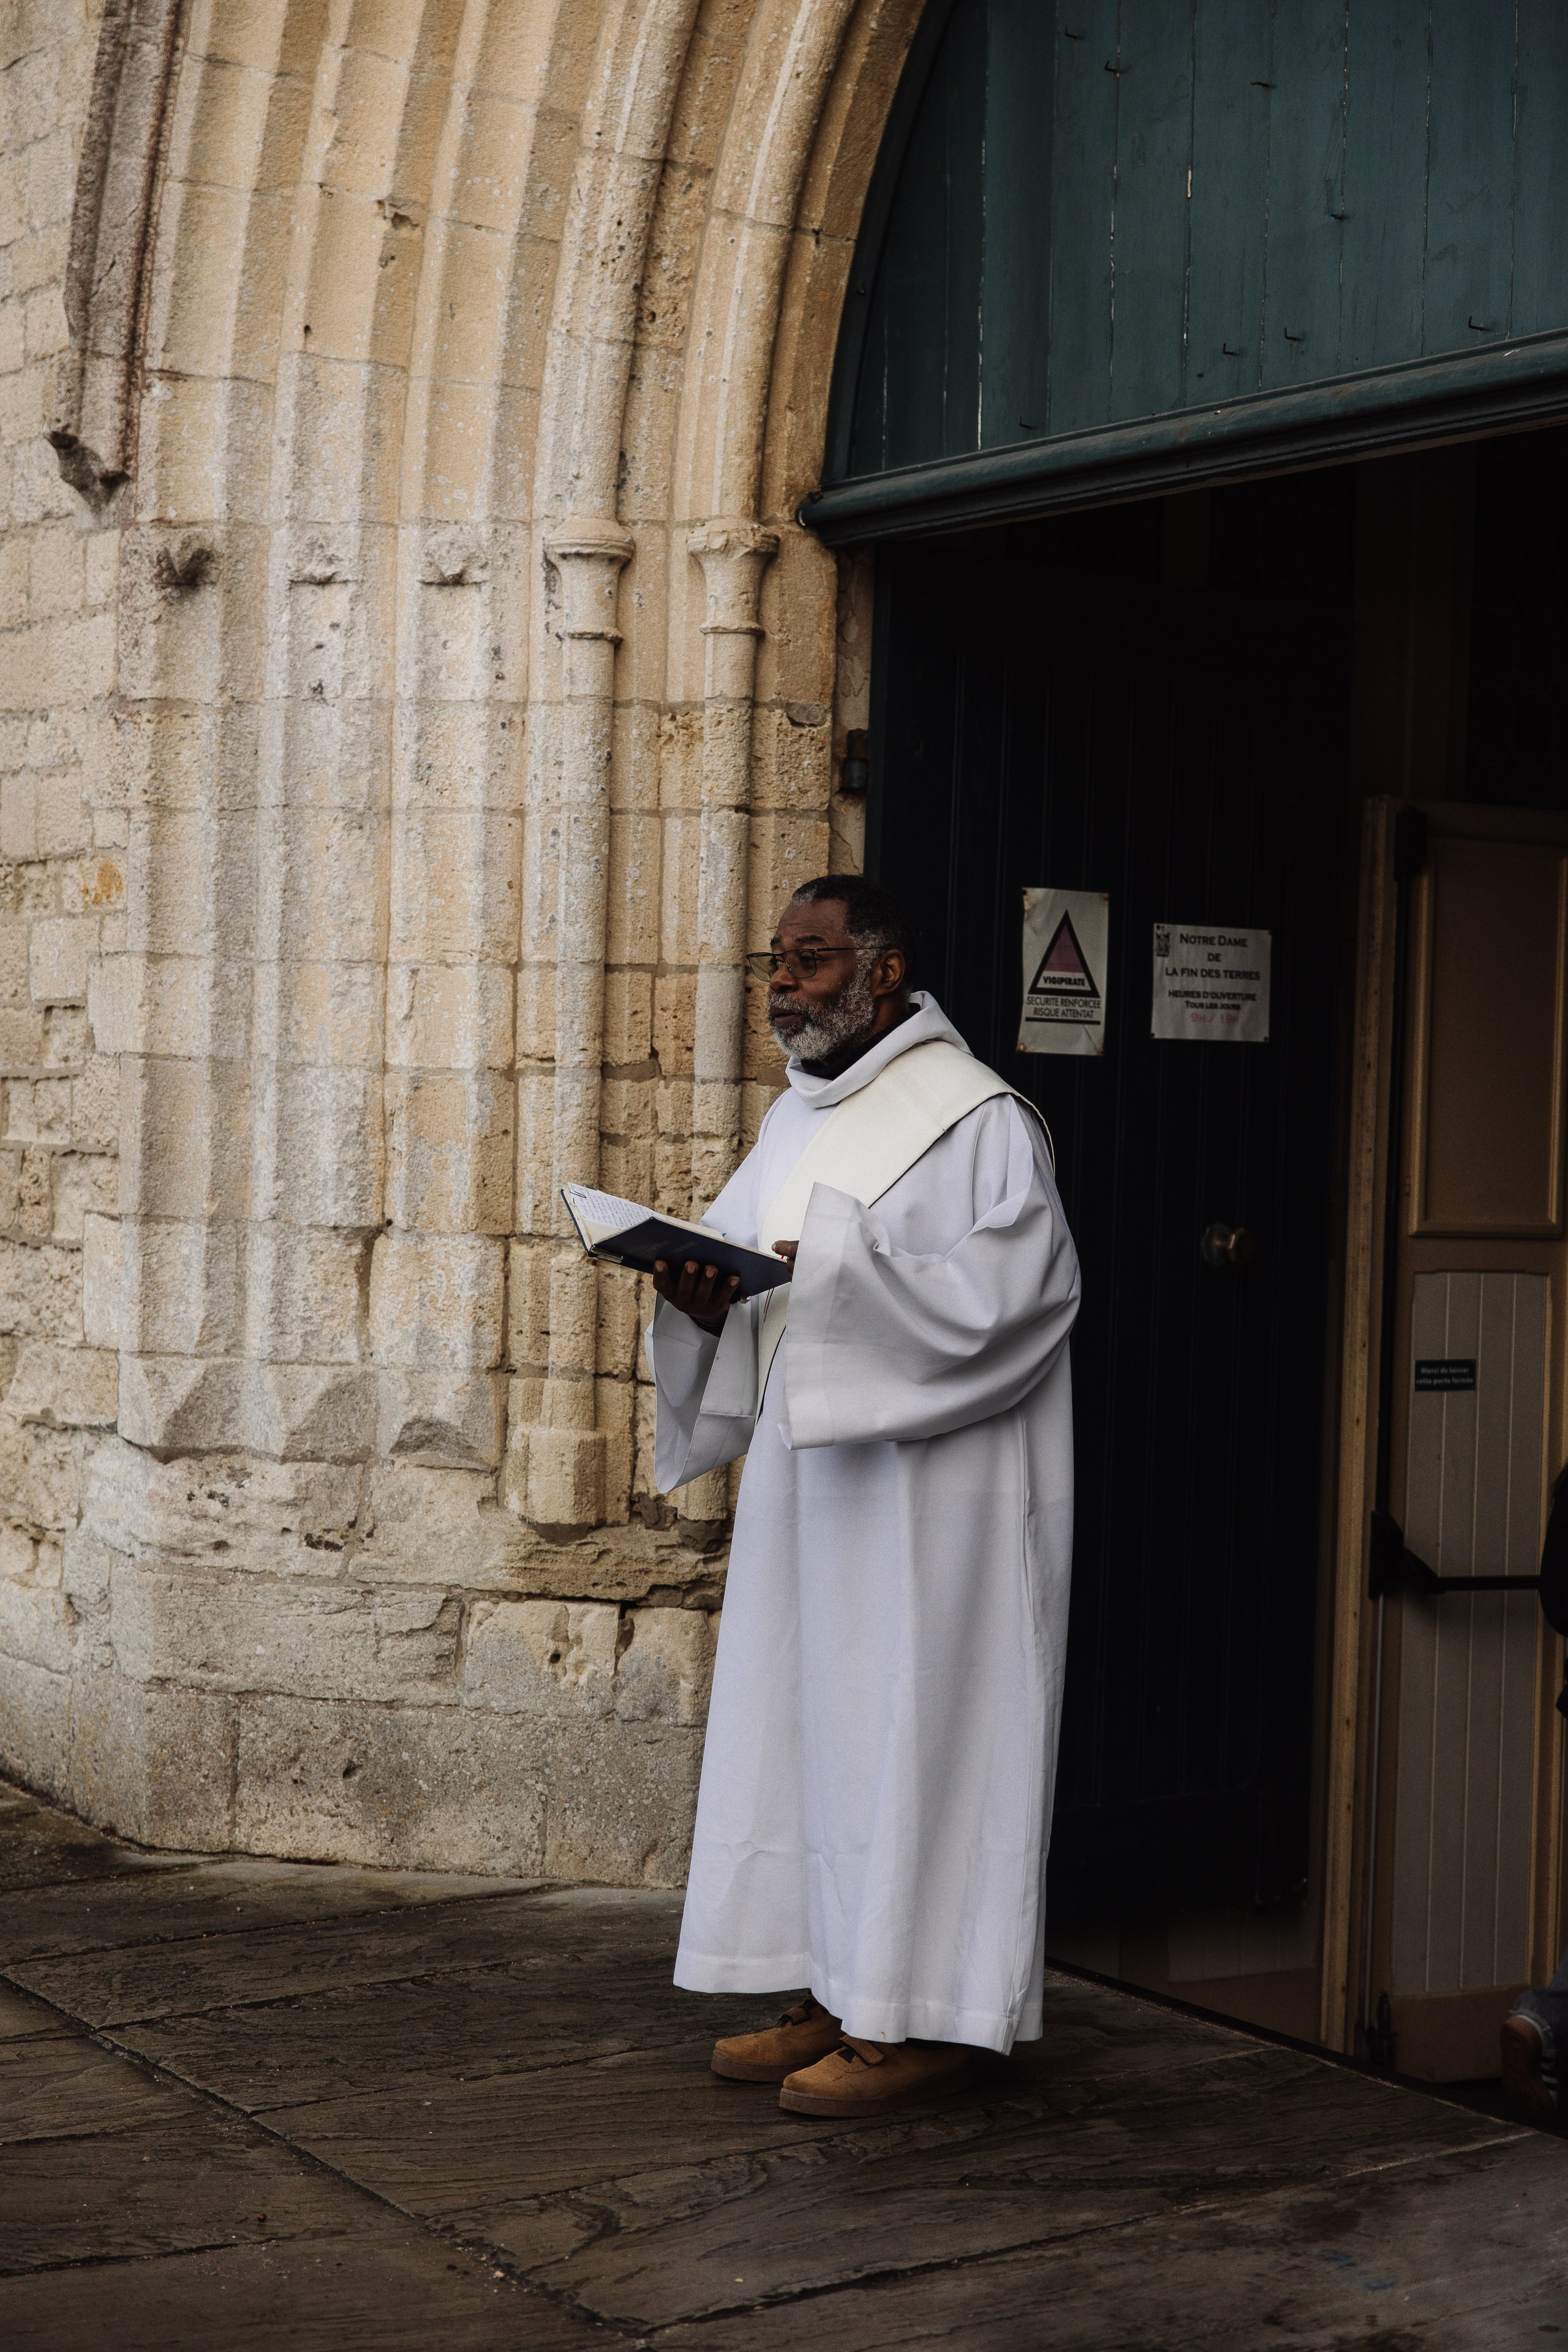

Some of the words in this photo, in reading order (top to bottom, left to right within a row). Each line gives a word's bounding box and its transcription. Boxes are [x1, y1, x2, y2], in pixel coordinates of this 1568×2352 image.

[1165, 968, 1178, 976] LA
[1181, 968, 1197, 977] FIN
[1200, 970, 1220, 978] DES
[1223, 970, 1260, 980] TERRES
[1042, 976, 1085, 986] VIGIPIRATE
[1168, 990, 1201, 999] HEURES
[1203, 990, 1257, 1001] D'OUVERTURE
[1033, 1008, 1059, 1017] RISQUE
[1061, 1009, 1094, 1019] ATTENTAT
